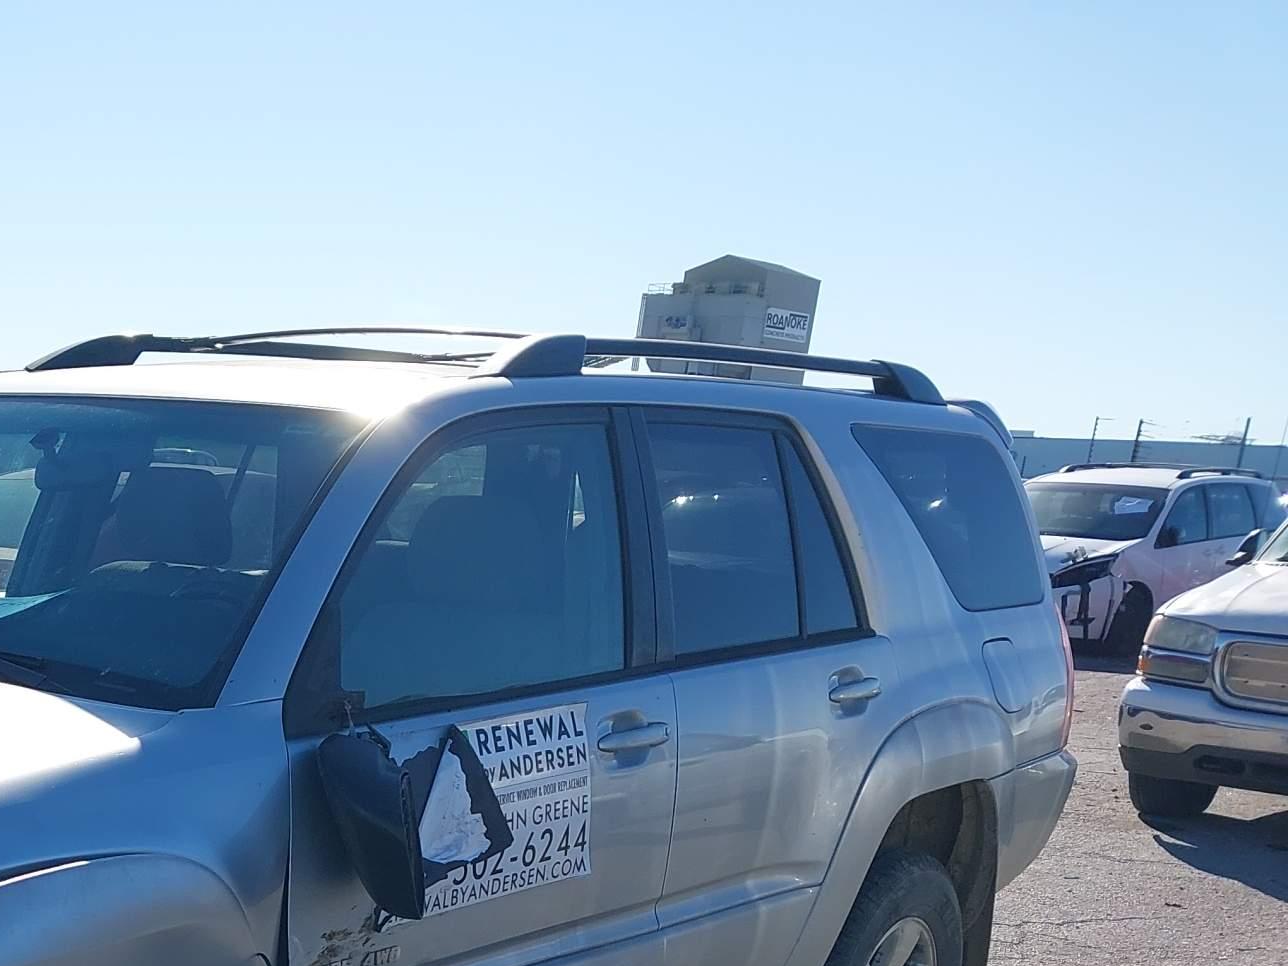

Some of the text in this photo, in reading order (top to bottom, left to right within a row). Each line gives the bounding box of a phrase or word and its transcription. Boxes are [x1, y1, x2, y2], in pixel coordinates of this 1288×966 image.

[766, 313, 809, 331] ROANOKE
[475, 711, 584, 757] RENEWAL
[498, 742, 587, 782] ANDERSEN
[497, 791, 516, 805] ERVICE
[558, 776, 588, 793] REPLACEMENT
[505, 795, 589, 831] HN GREENE
